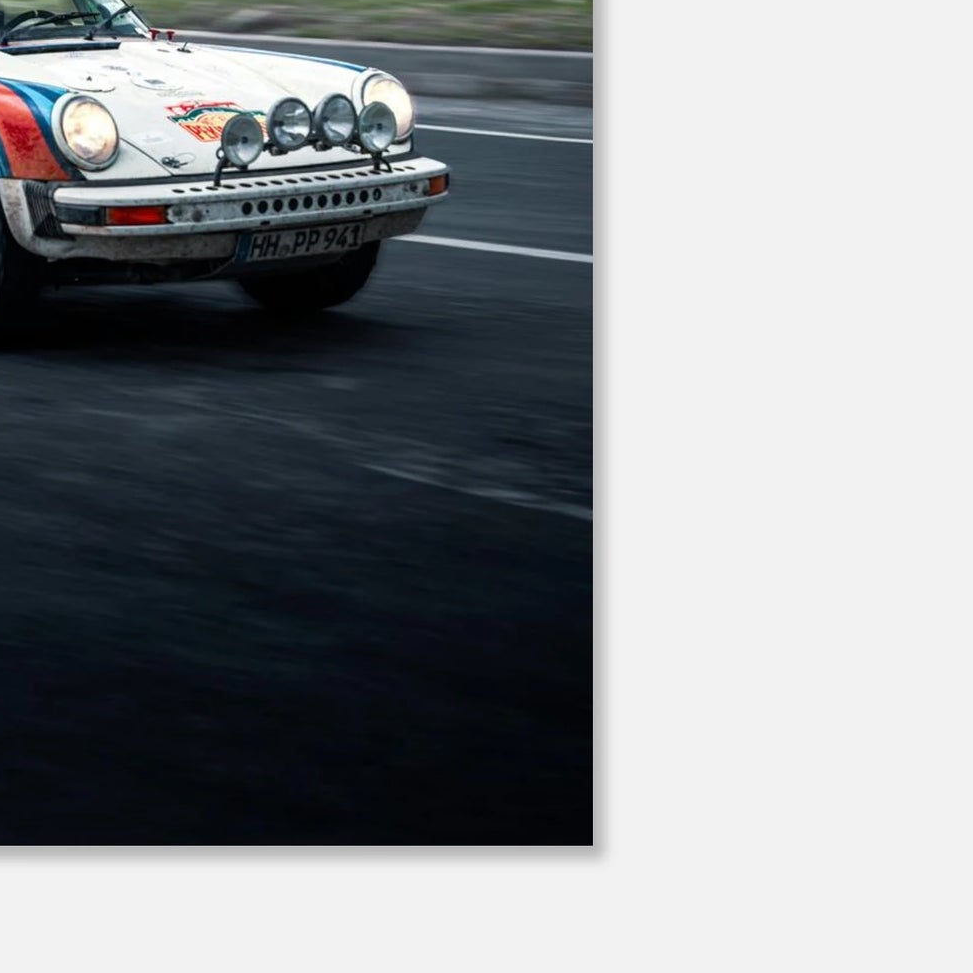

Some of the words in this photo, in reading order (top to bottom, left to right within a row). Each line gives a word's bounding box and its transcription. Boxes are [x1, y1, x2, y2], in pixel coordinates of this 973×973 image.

[250, 233, 280, 259] HH
[292, 230, 321, 253] PP
[324, 225, 360, 249] 941
